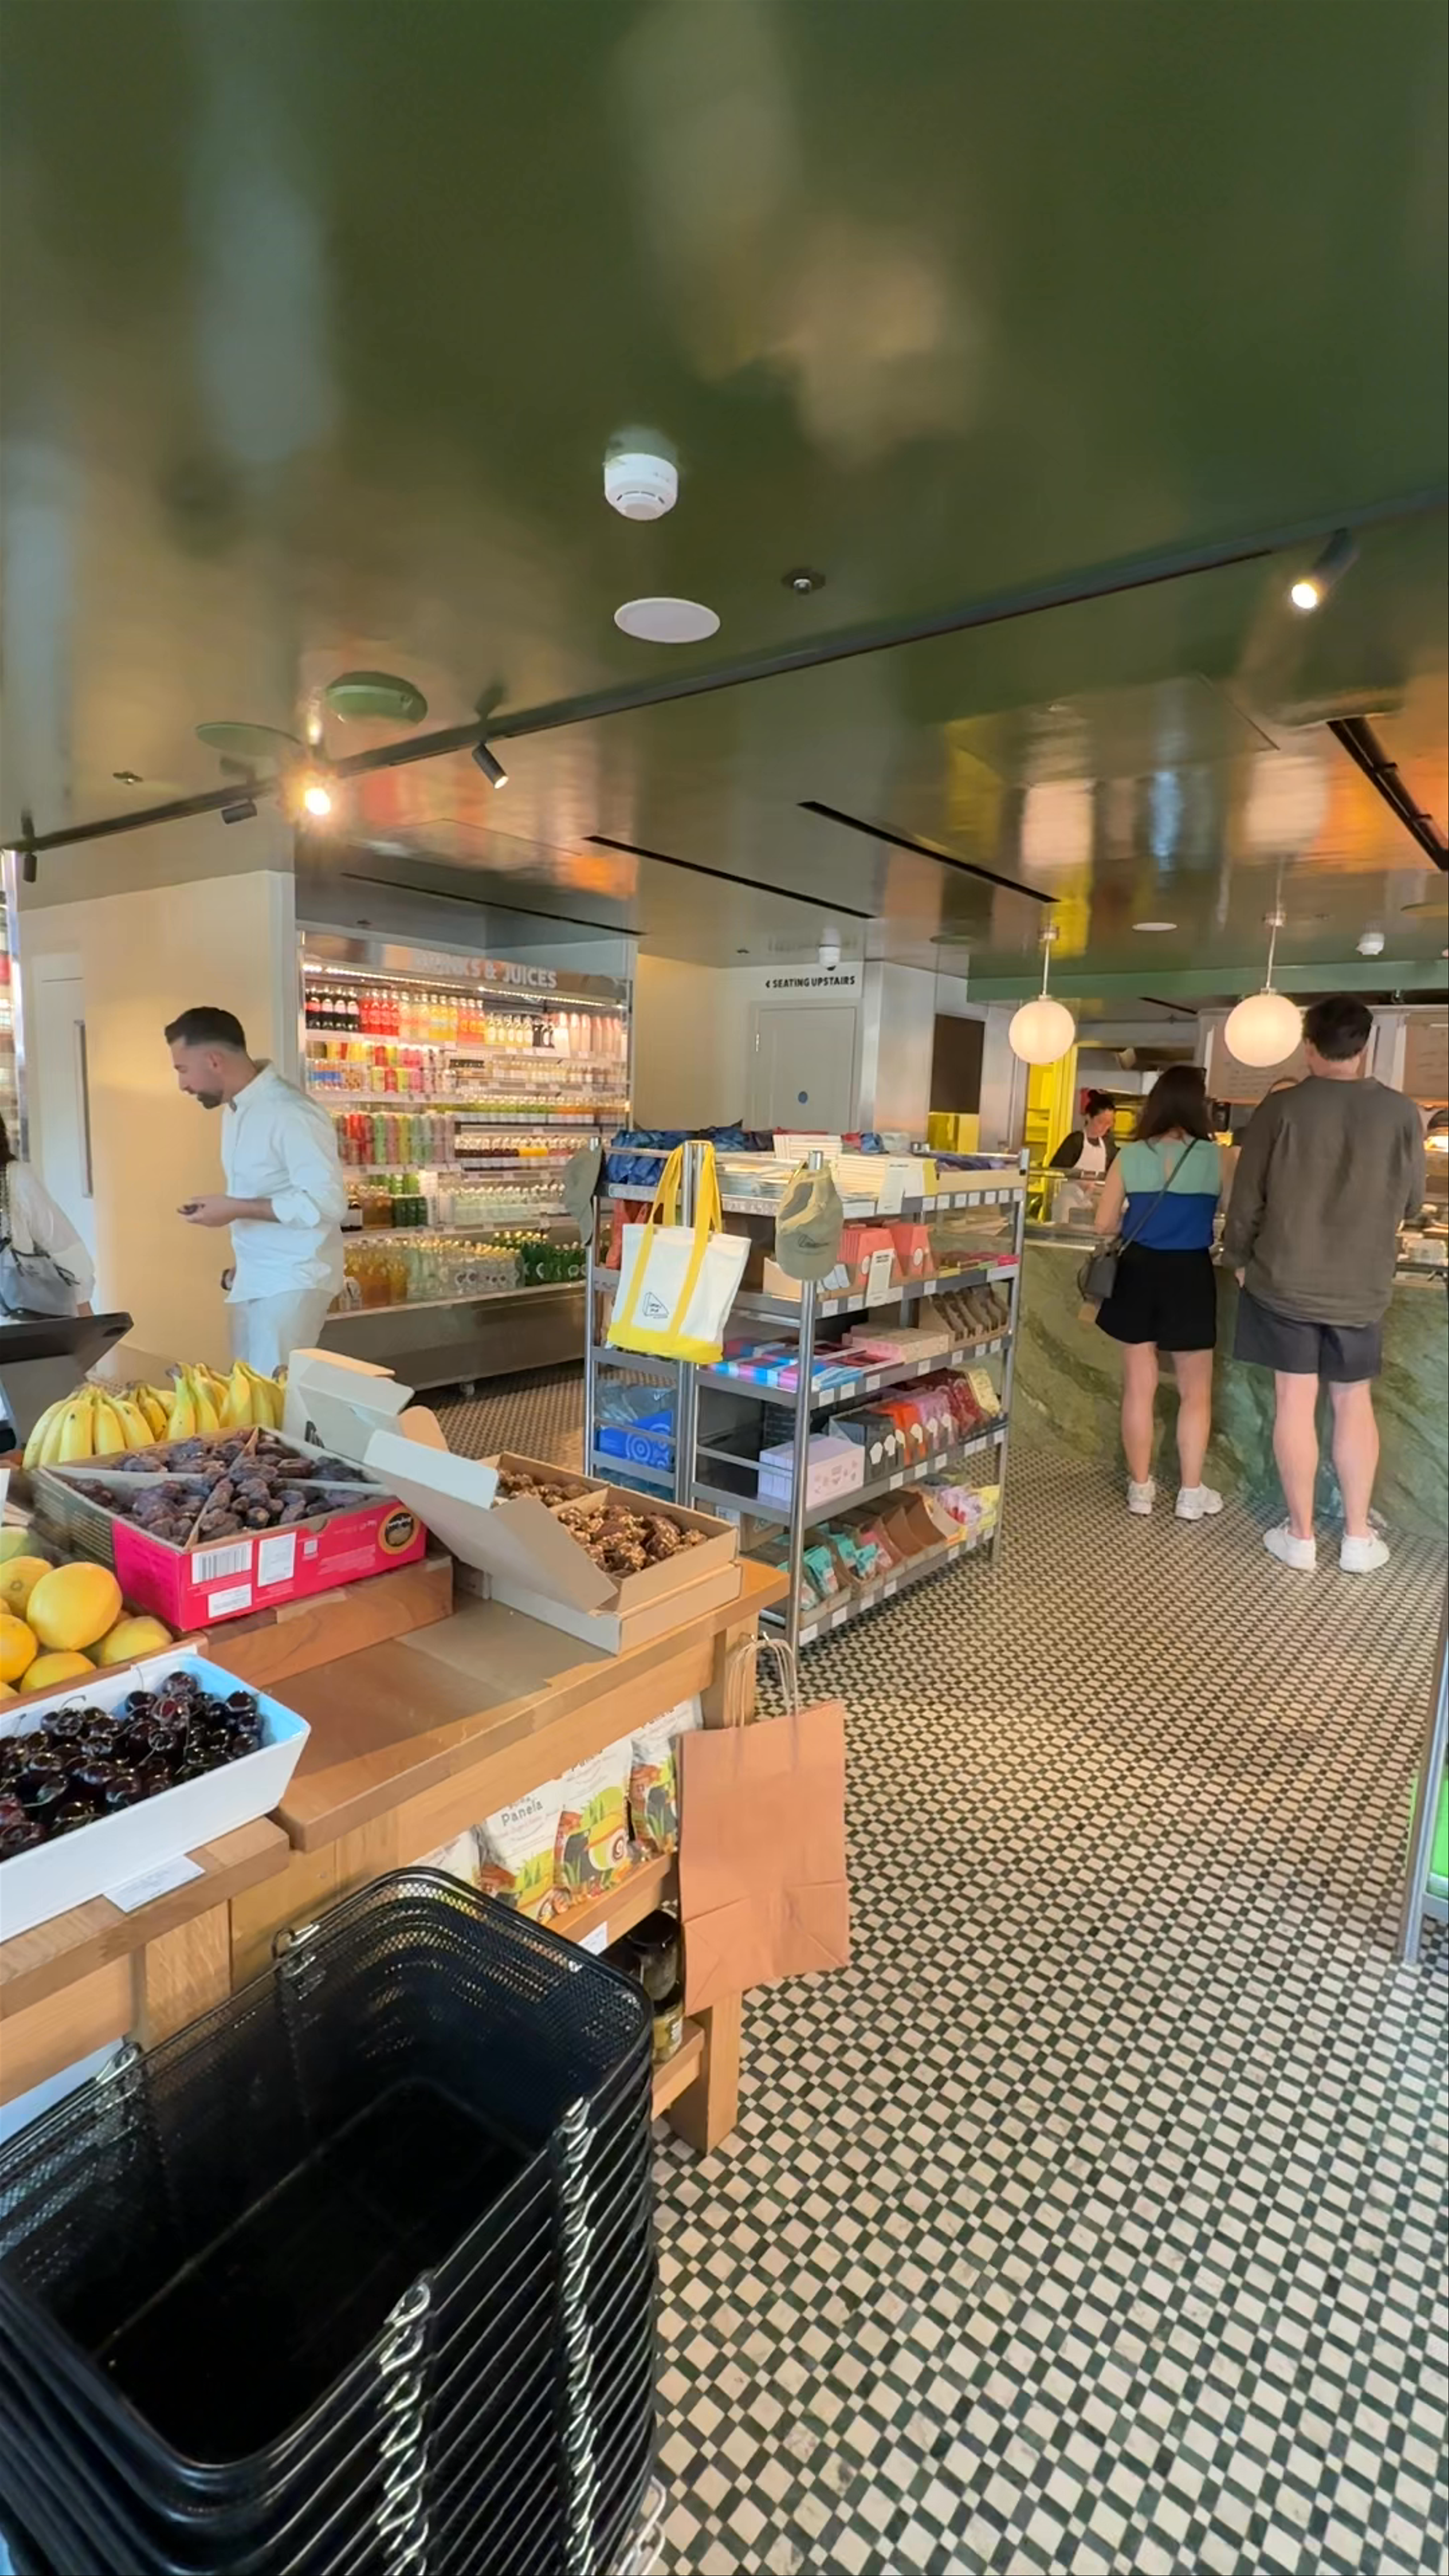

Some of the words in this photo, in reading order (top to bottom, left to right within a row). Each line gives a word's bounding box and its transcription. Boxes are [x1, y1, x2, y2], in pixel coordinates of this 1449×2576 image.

[503, 964, 557, 989] JUICES
[772, 978, 810, 988] SEATING
[811, 976, 855, 987] UPSTAIRS
[501, 1799, 543, 1827] Panela
